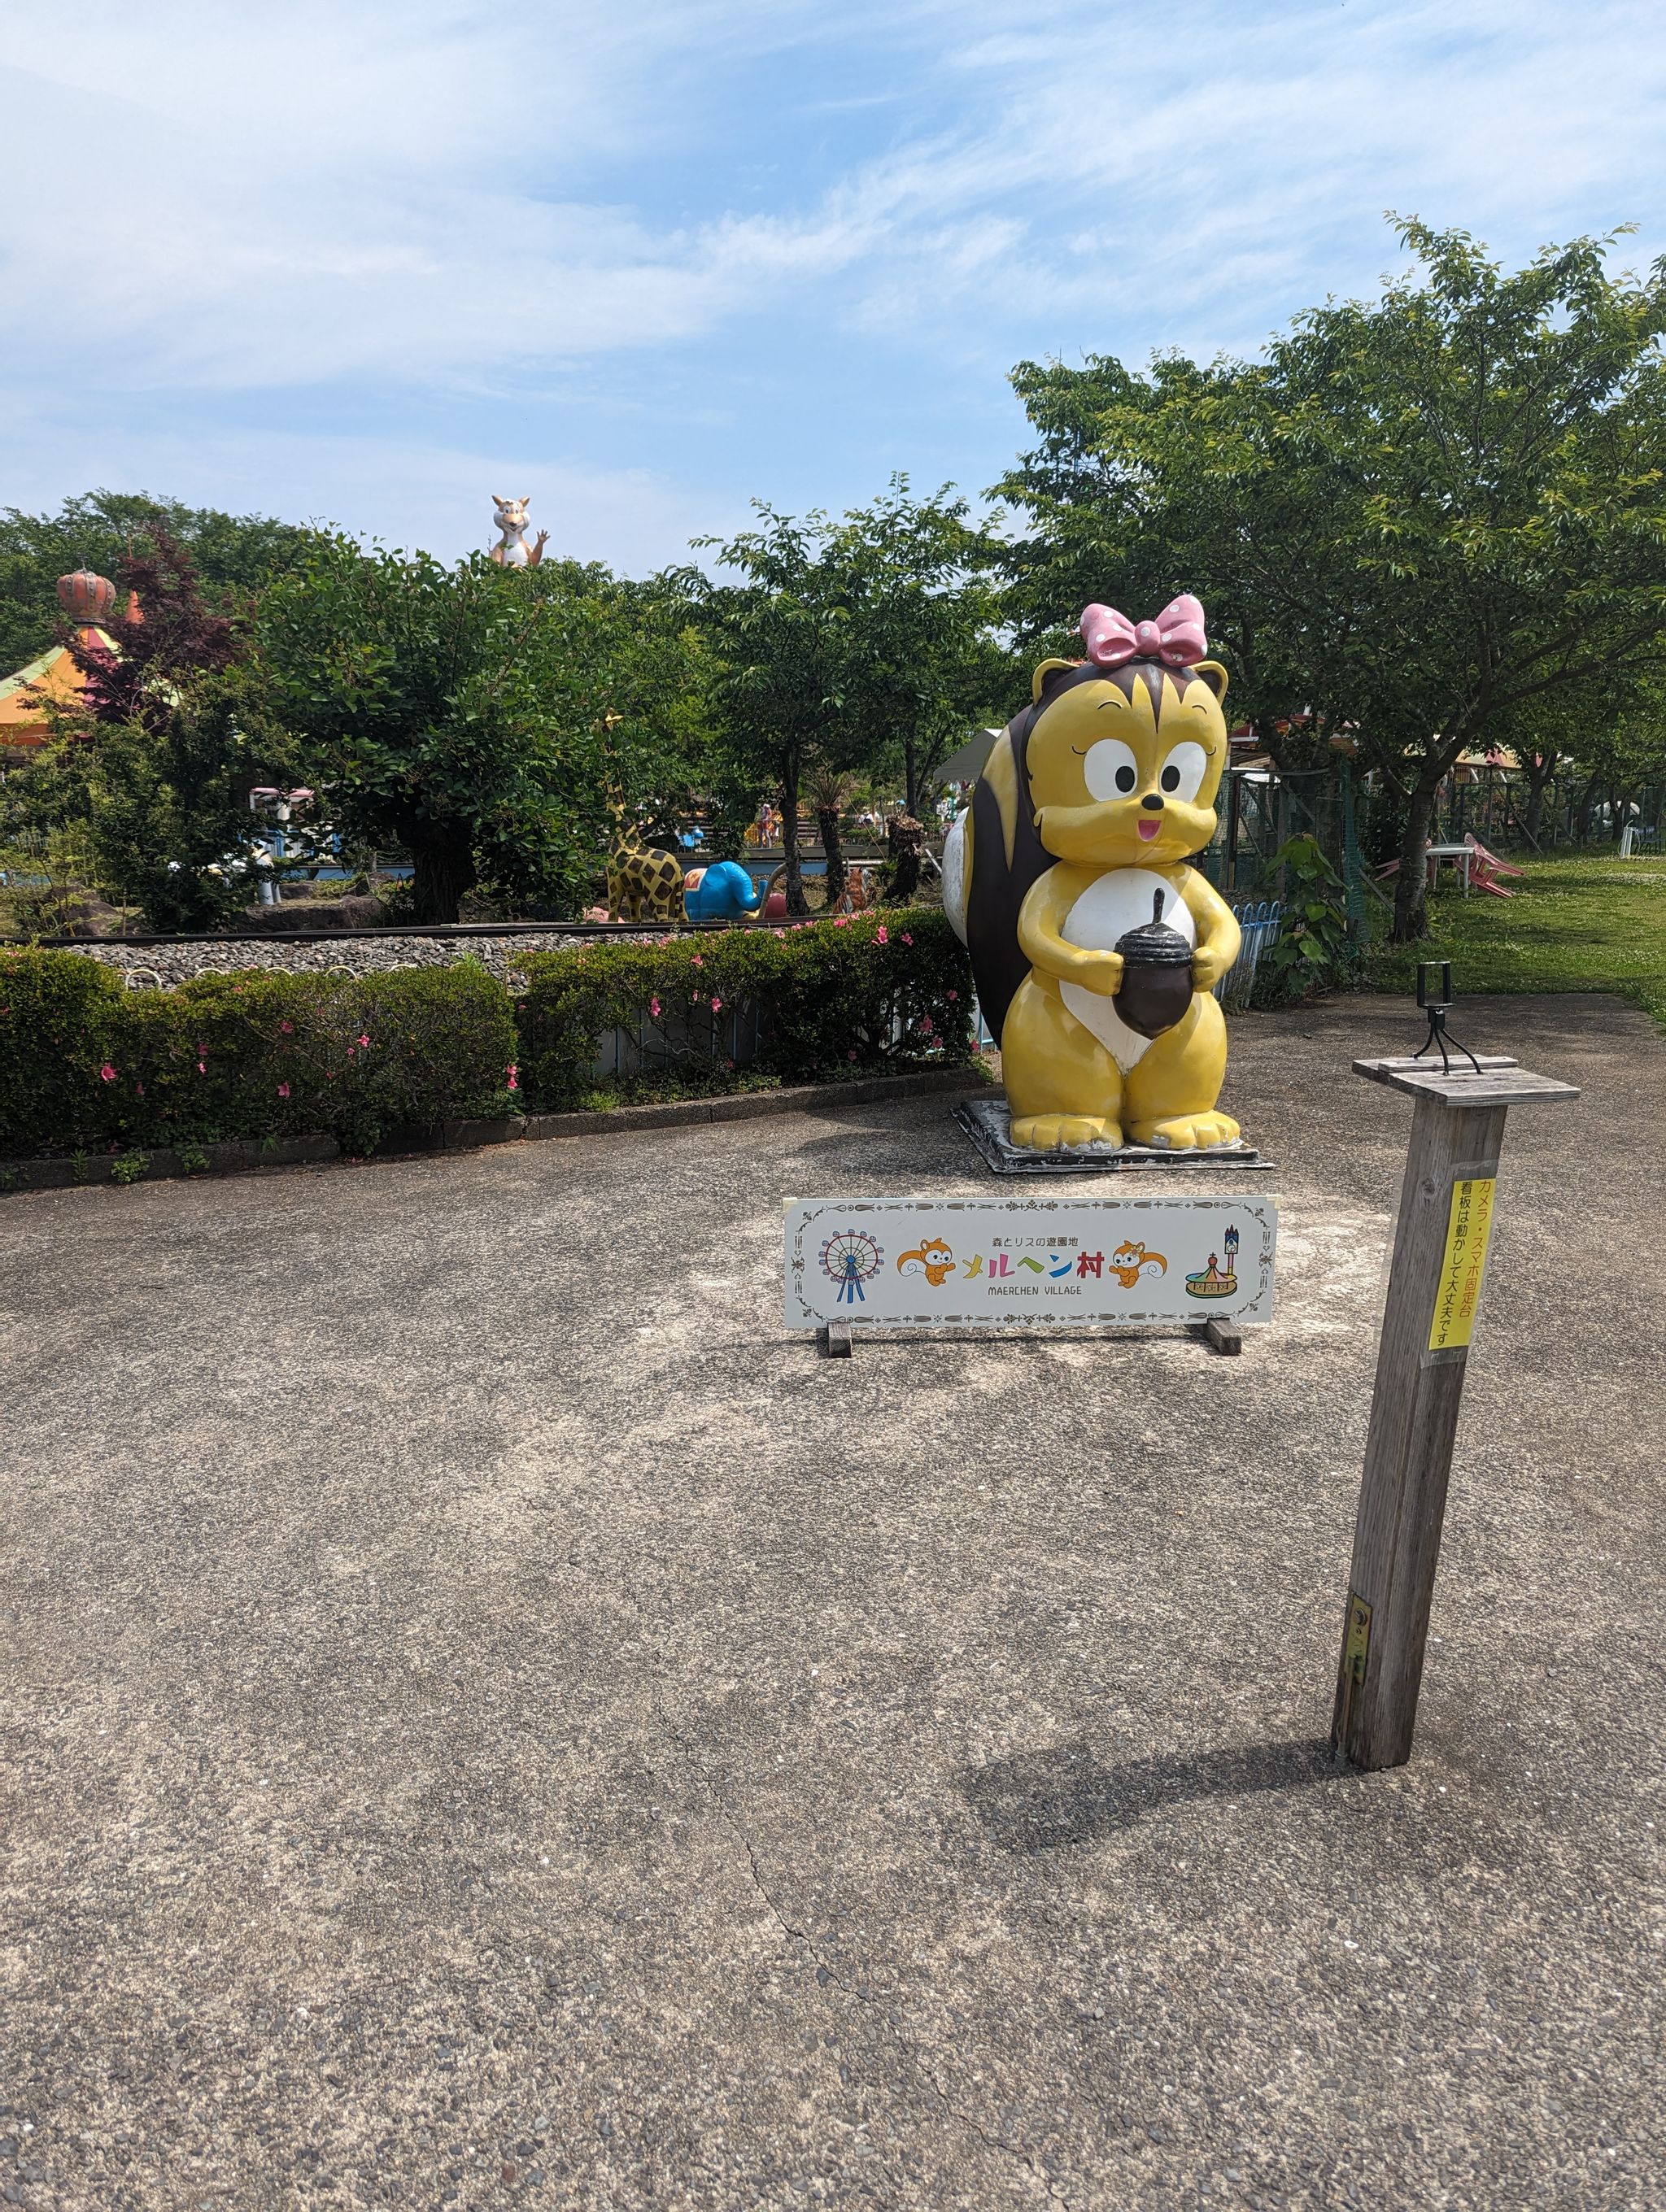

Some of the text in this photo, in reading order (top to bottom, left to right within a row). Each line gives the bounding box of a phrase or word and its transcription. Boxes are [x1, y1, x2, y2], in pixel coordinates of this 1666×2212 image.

[992, 1236, 1079, 1248] 森とリスの遊園地
[1459, 1179, 1492, 1317] カメラ・スマホ固定台
[962, 1251, 1105, 1279] メルヘン村
[1437, 1181, 1473, 1346] 看板は動かして大丈夫です
[988, 1286, 1082, 1295] MAERCHEN VILLAGE
